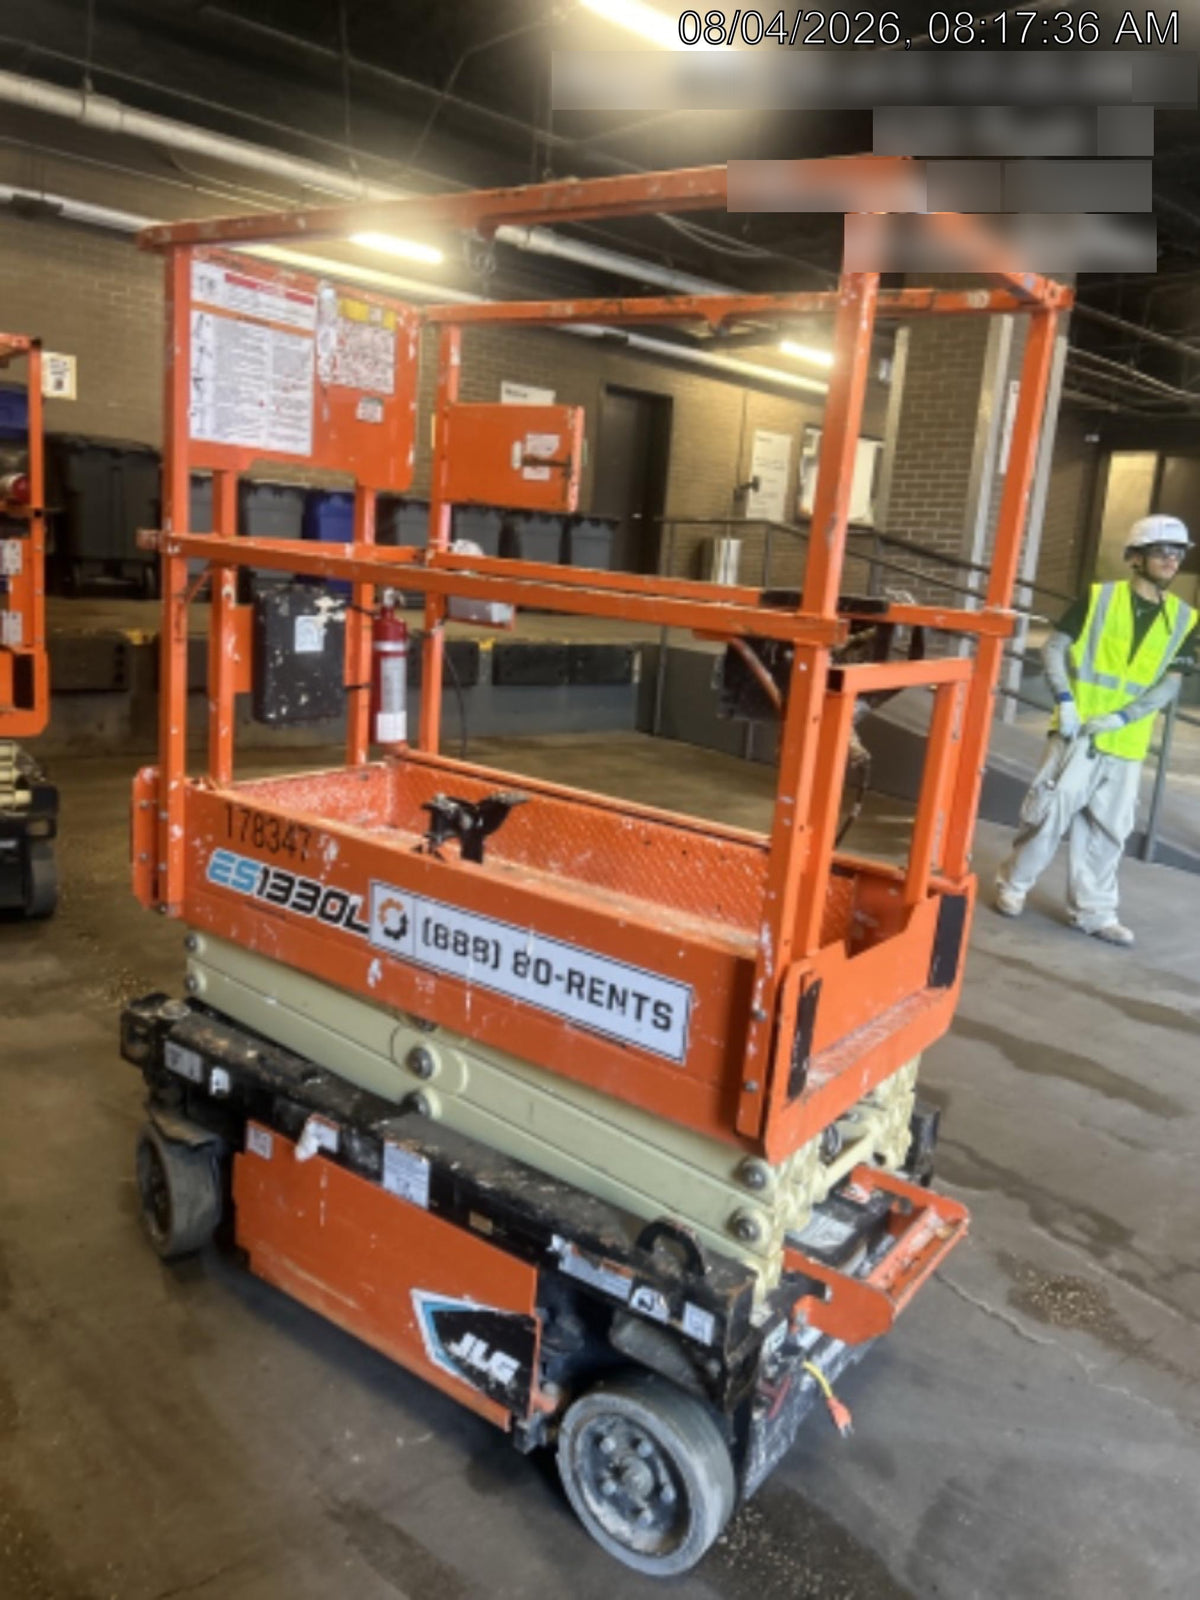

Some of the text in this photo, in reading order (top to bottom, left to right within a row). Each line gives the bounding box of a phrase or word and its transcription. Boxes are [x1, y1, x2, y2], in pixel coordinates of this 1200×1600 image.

[225, 801, 312, 862] 178347
[207, 848, 369, 936] ES1330L
[421, 916, 674, 1032] (888) 80-RENTS
